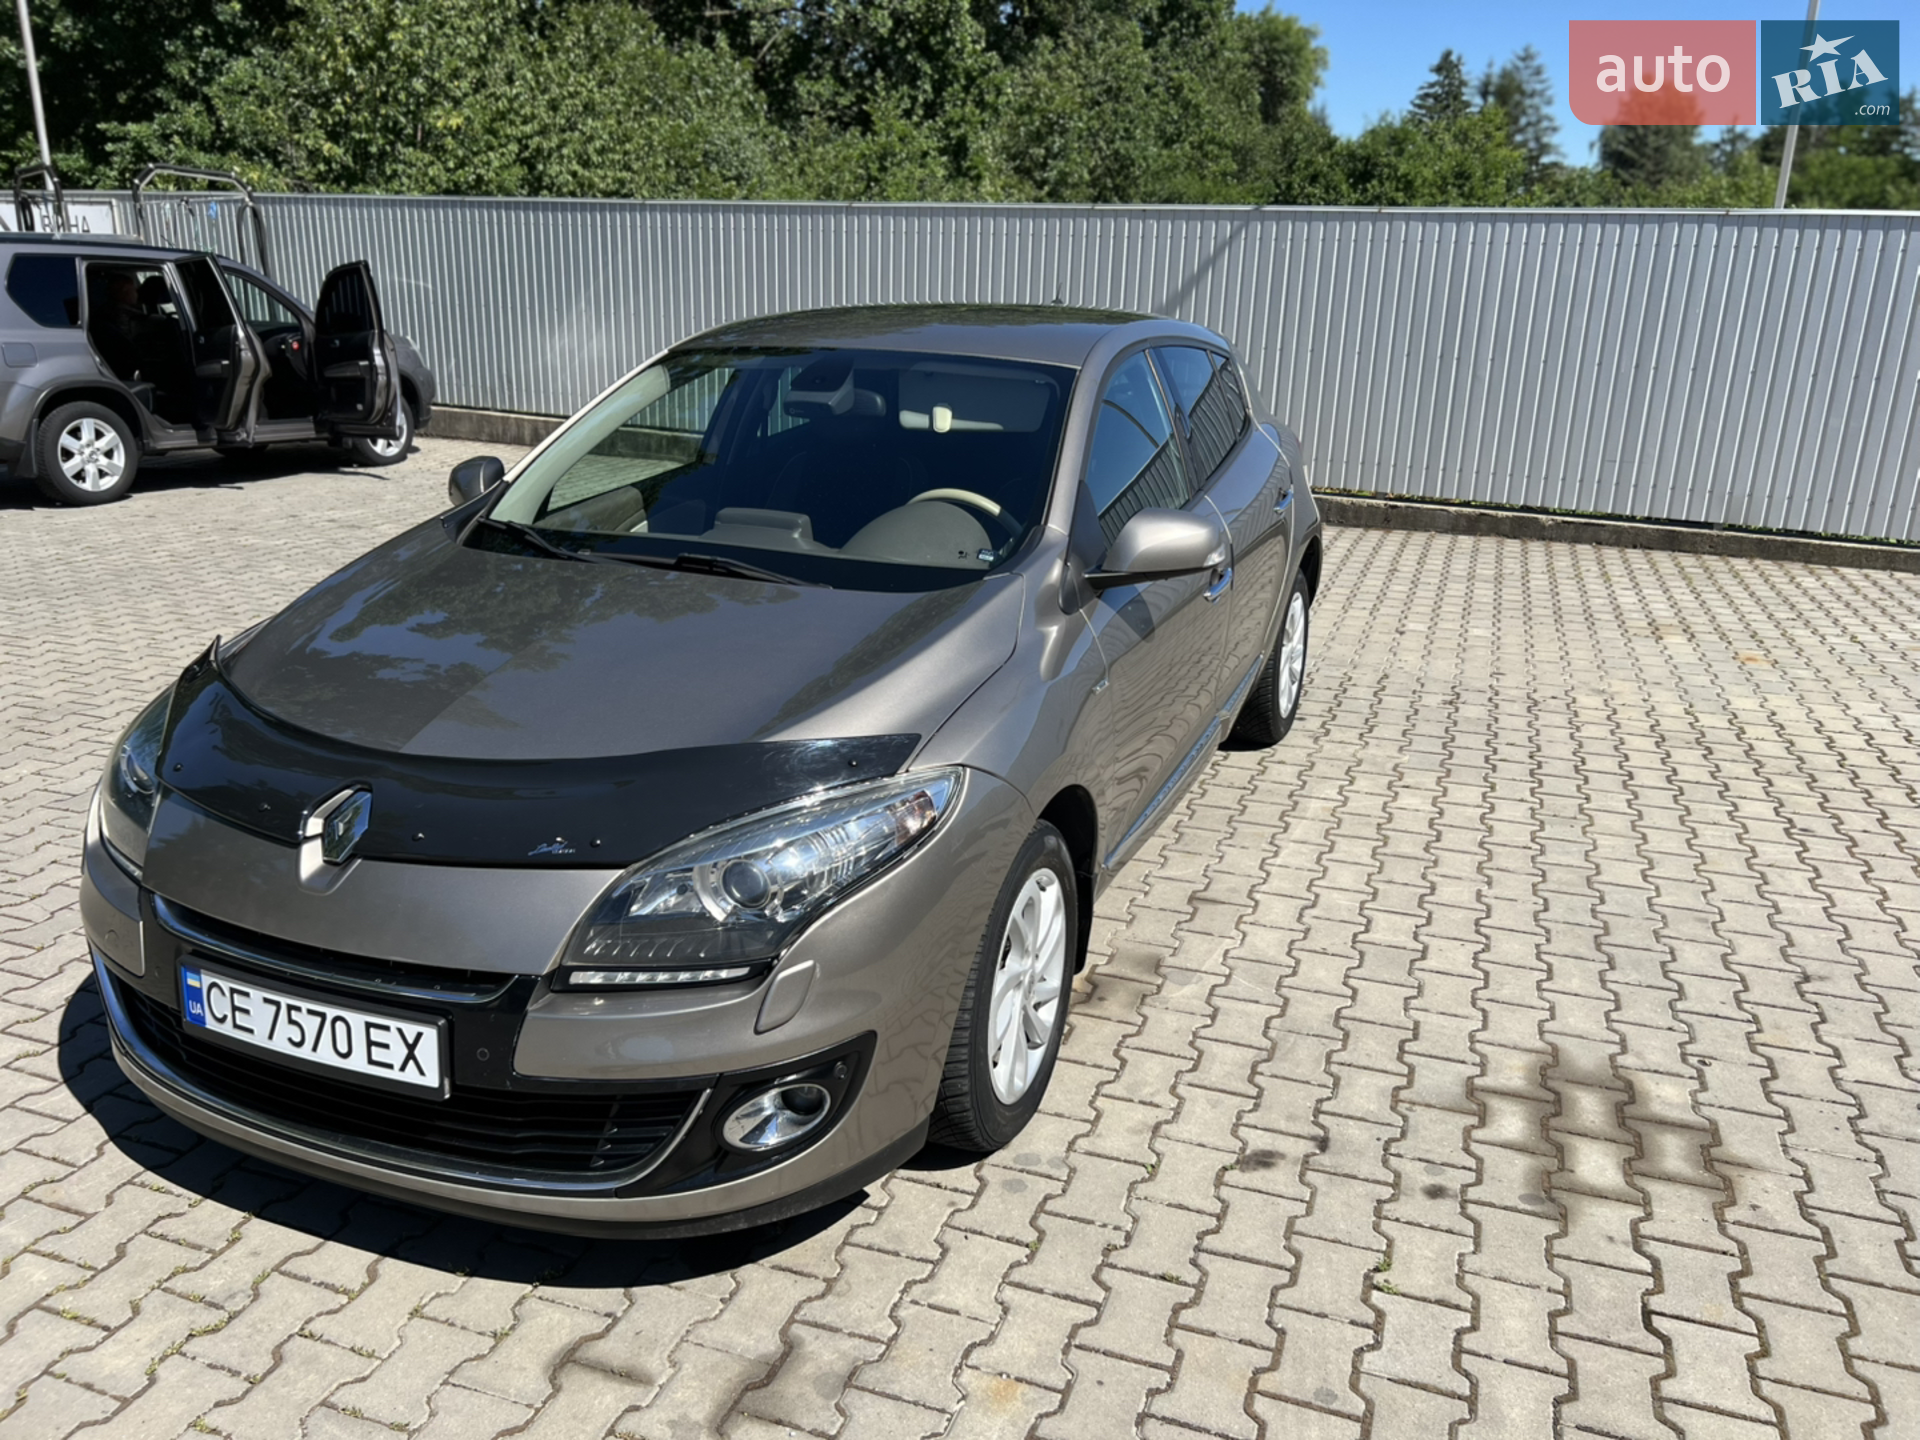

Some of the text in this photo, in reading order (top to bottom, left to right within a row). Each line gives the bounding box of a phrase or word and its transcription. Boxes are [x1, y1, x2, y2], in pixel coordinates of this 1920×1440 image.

[188, 1000, 203, 1016] UA
[206, 981, 427, 1077] CE 7570 EX
